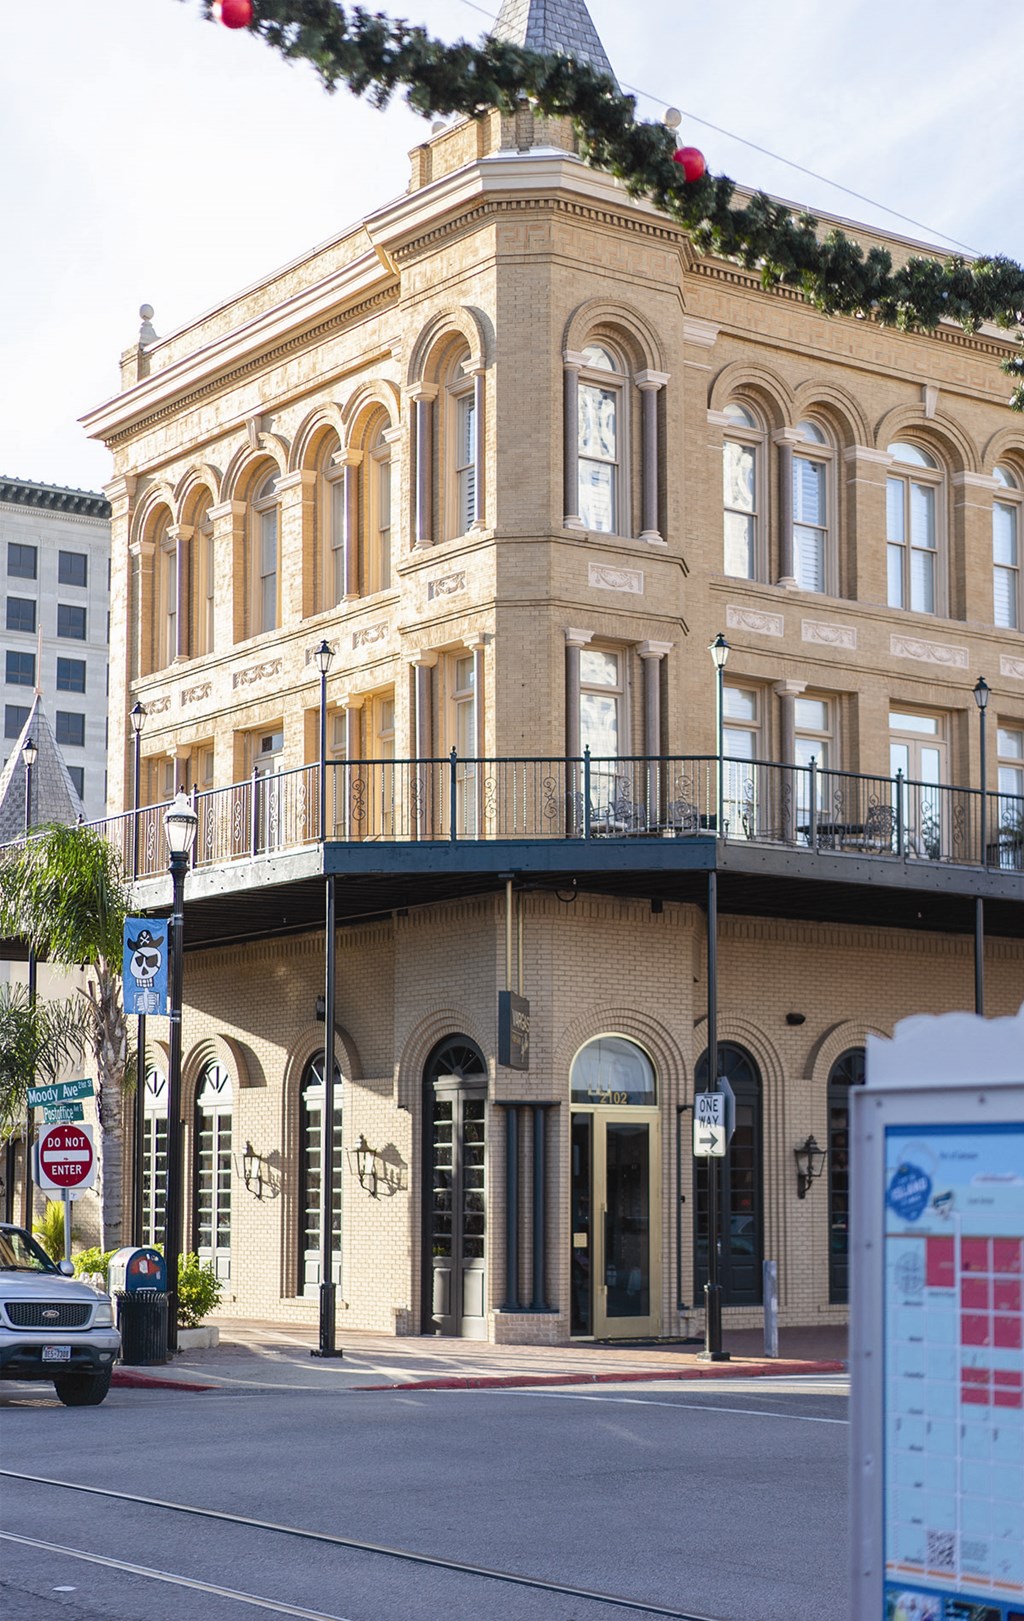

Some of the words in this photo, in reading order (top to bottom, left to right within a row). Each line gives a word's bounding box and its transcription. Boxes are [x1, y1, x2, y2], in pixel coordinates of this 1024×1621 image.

[28, 1087, 58, 1103] Moody
[63, 1084, 78, 1098] Ave
[77, 1081, 87, 1089] 21st
[600, 1092, 627, 1104] 2102
[700, 1099, 718, 1112] ONE
[43, 1106, 74, 1121] Postoffice
[699, 1115, 719, 1128] WAY
[47, 1137, 60, 1147] DO
[65, 1137, 85, 1147] NOT
[52, 1165, 82, 1175] ENTER
